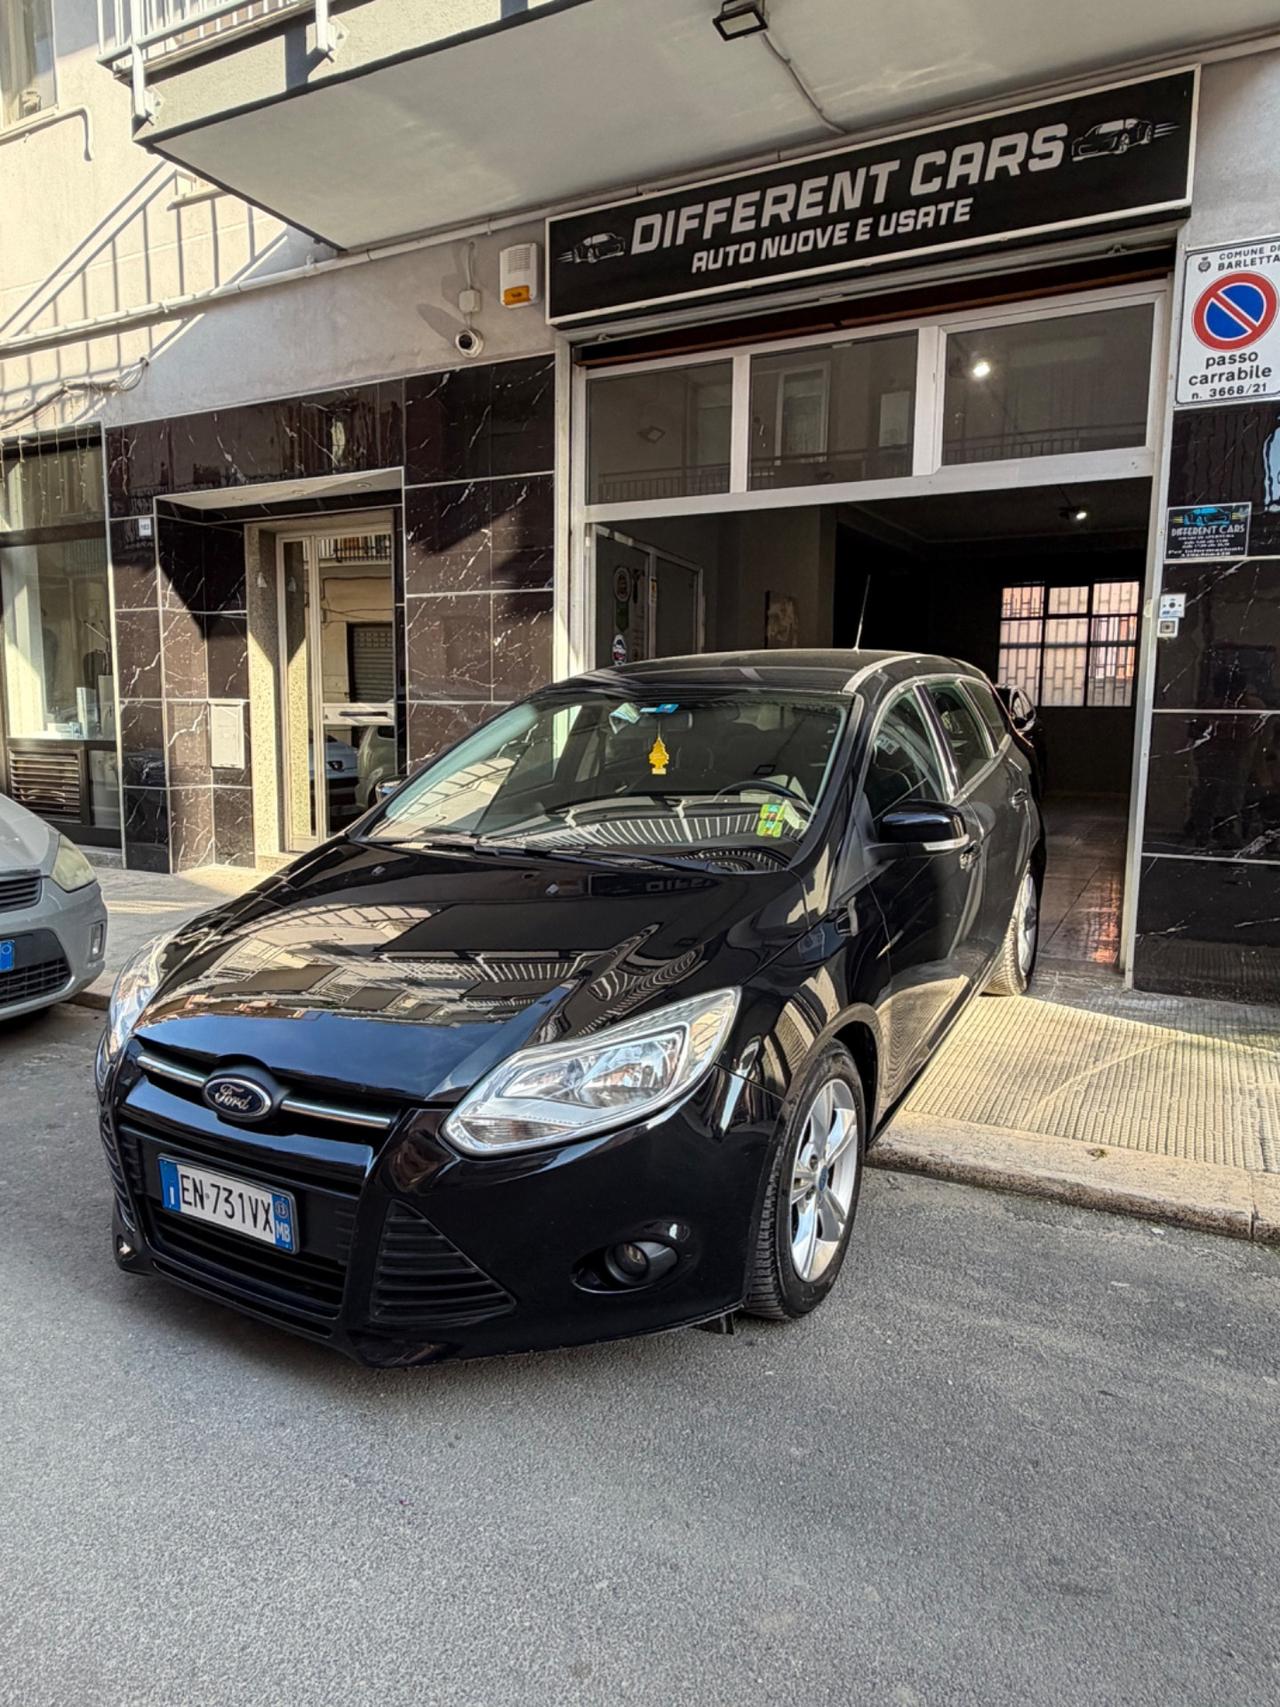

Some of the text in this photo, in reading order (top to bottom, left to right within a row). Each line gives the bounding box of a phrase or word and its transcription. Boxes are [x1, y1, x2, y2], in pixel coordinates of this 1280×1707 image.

[630, 123, 1068, 255] DIFFERENT CARS
[691, 197, 975, 274] AUTO NUOVE E USATE
[1217, 254, 1280, 271] BARLETTA
[1219, 247, 1264, 260] COMUNE
[1205, 351, 1258, 369] passo
[1188, 365, 1272, 386] carrabile
[1191, 382, 1267, 400] n. 3668/21
[1171, 524, 1245, 536] DIFFERENT CARS
[214, 1084, 251, 1110] Ford
[275, 1220, 291, 1242] MB
